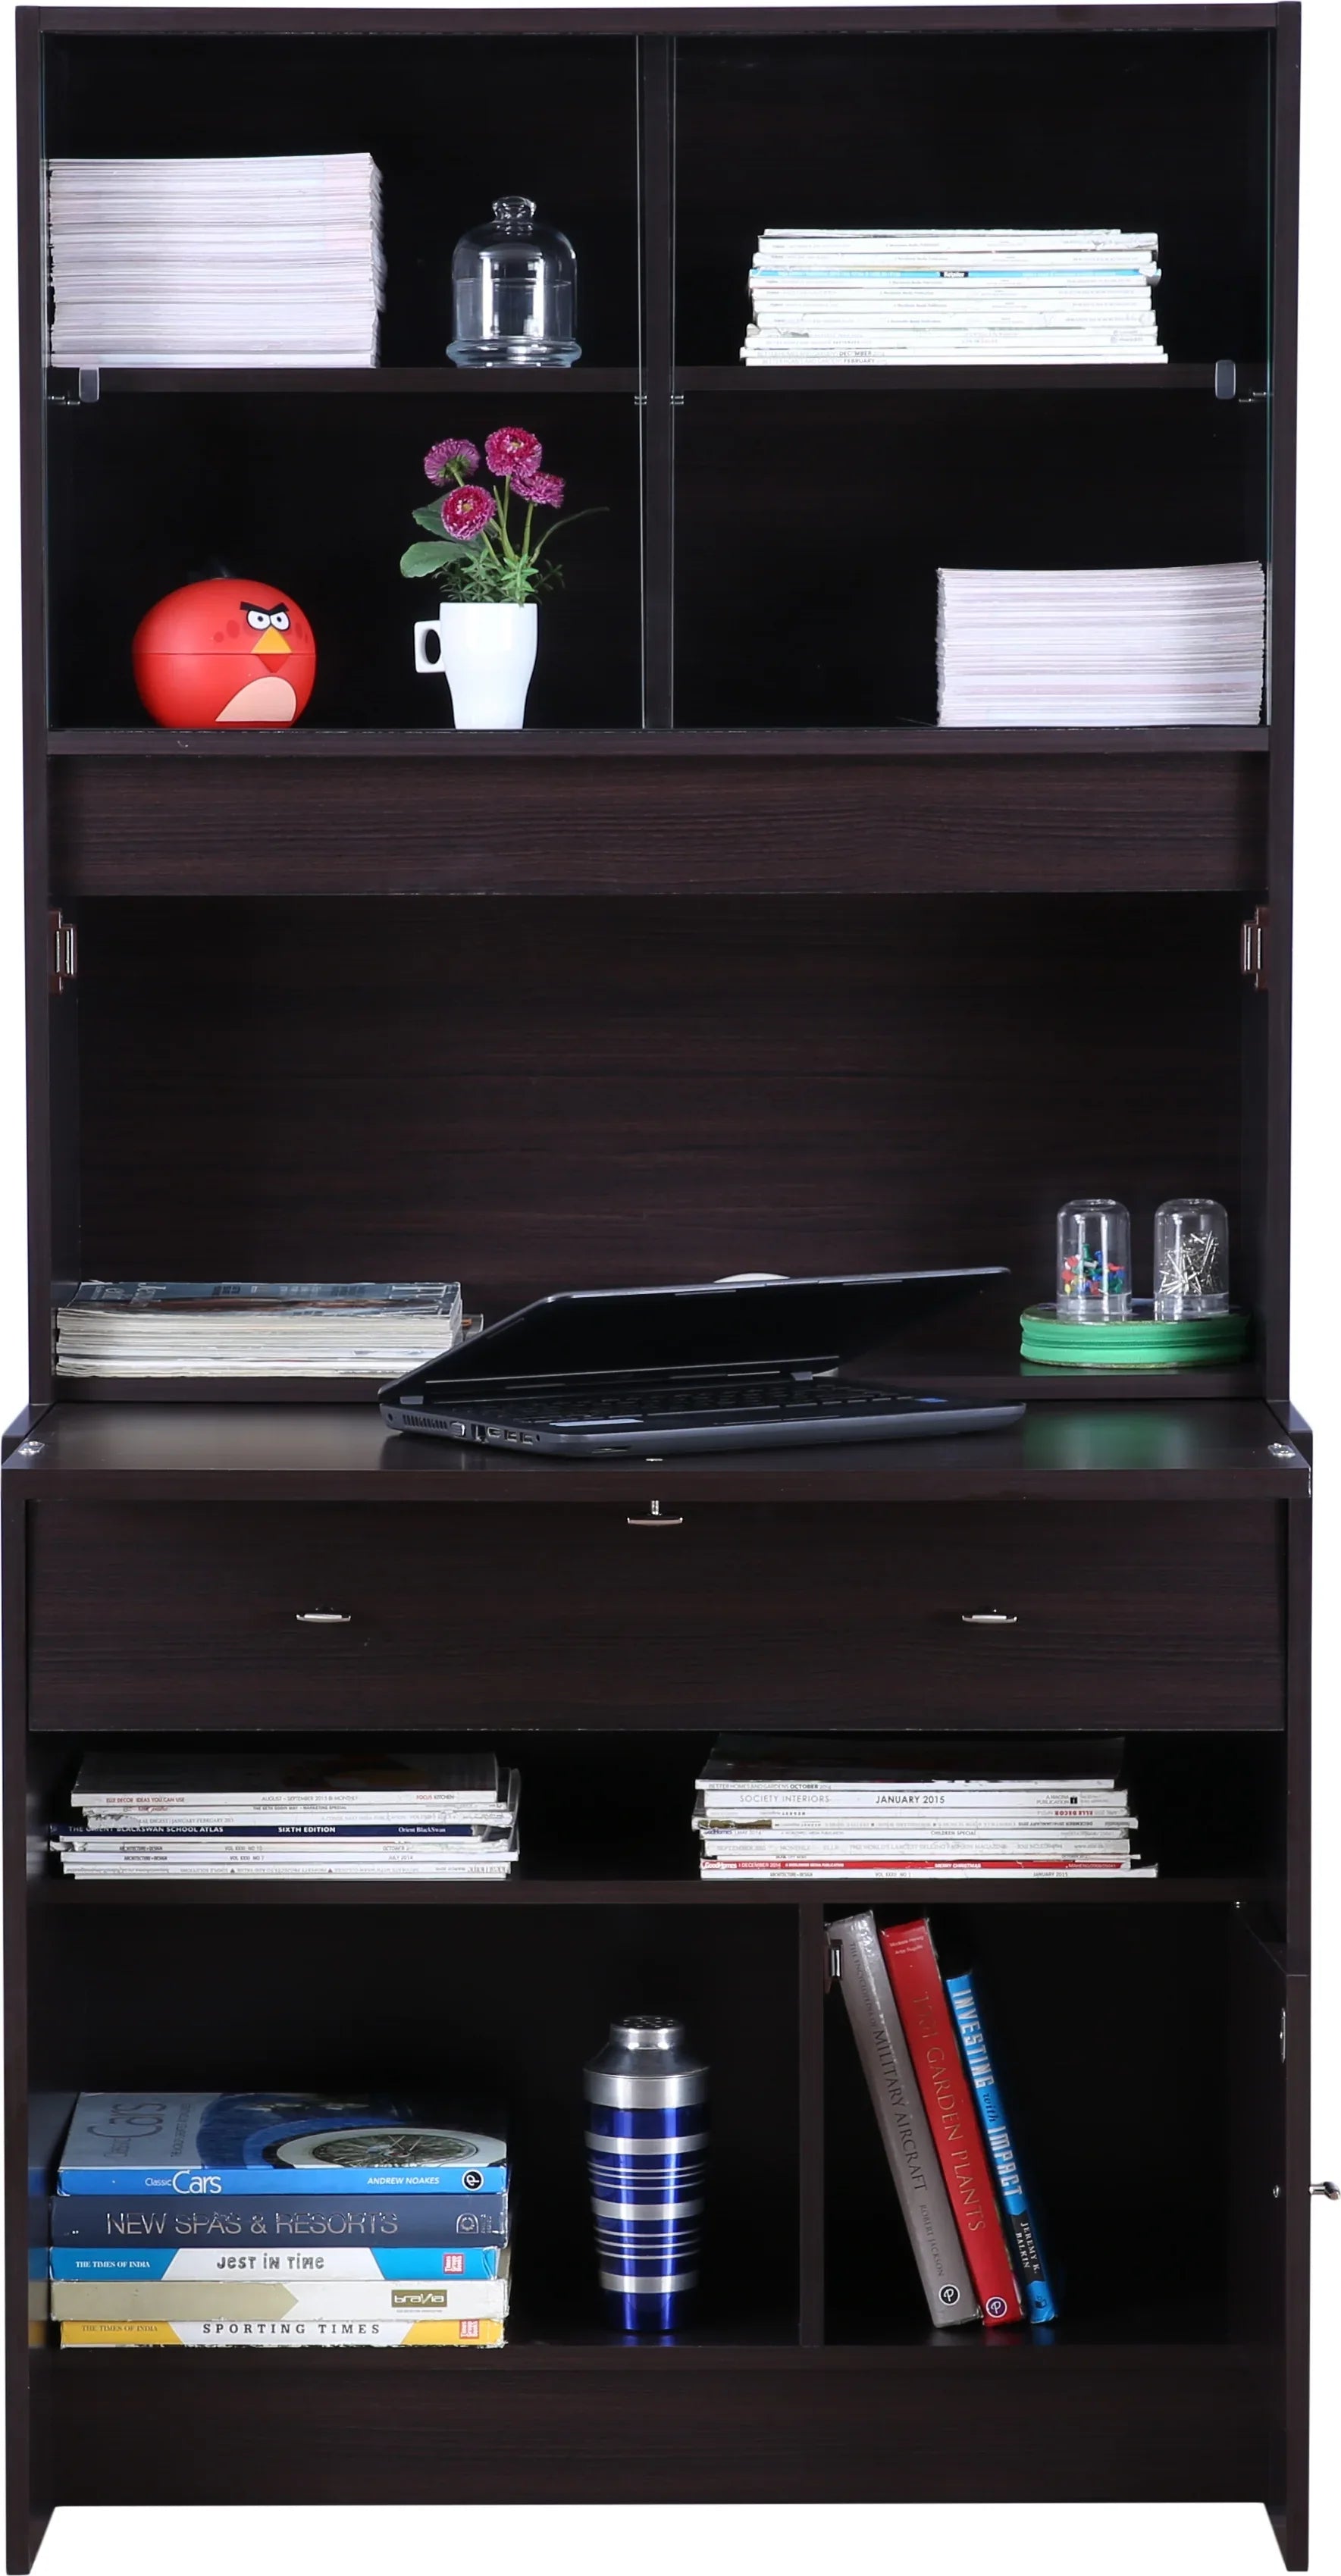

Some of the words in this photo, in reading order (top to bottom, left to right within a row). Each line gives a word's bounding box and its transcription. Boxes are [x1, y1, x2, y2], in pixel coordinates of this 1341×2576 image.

[739, 1794, 779, 1803] SOCIETY
[782, 1794, 830, 1803] INTERIORS
[876, 1795, 920, 1804] JANUARY
[923, 1795, 945, 1804] 2015
[704, 1861, 737, 1869] GoodHomes
[952, 1988, 994, 2090] INVESTING
[872, 2029, 906, 2109] MILITARY
[893, 2111, 928, 2192] AIRCRAFT
[982, 2092, 998, 2123] with
[926, 2047, 963, 2142] GARDEN
[951, 2148, 986, 2233] PLANTS
[987, 2125, 1023, 2198] IMPACT
[145, 2177, 172, 2186] Classic
[172, 2170, 222, 2194] Cars
[367, 2176, 405, 2185] ANDREW
[405, 2176, 440, 2185] NOAKES
[107, 2212, 167, 2235] NEW
[175, 2211, 242, 2235] SPAS
[250, 2213, 268, 2234] &
[275, 2211, 399, 2235] RESORTS
[919, 2203, 934, 2236] ROBERT
[926, 2236, 945, 2277] JACKSON
[1014, 2231, 1031, 2270] BALKIN
[1020, 2221, 1039, 2263] JEREMY
[136, 2324, 158, 2332] INDIA
[202, 2324, 305, 2334] SPORTING
[318, 2324, 380, 2334] TIMES
